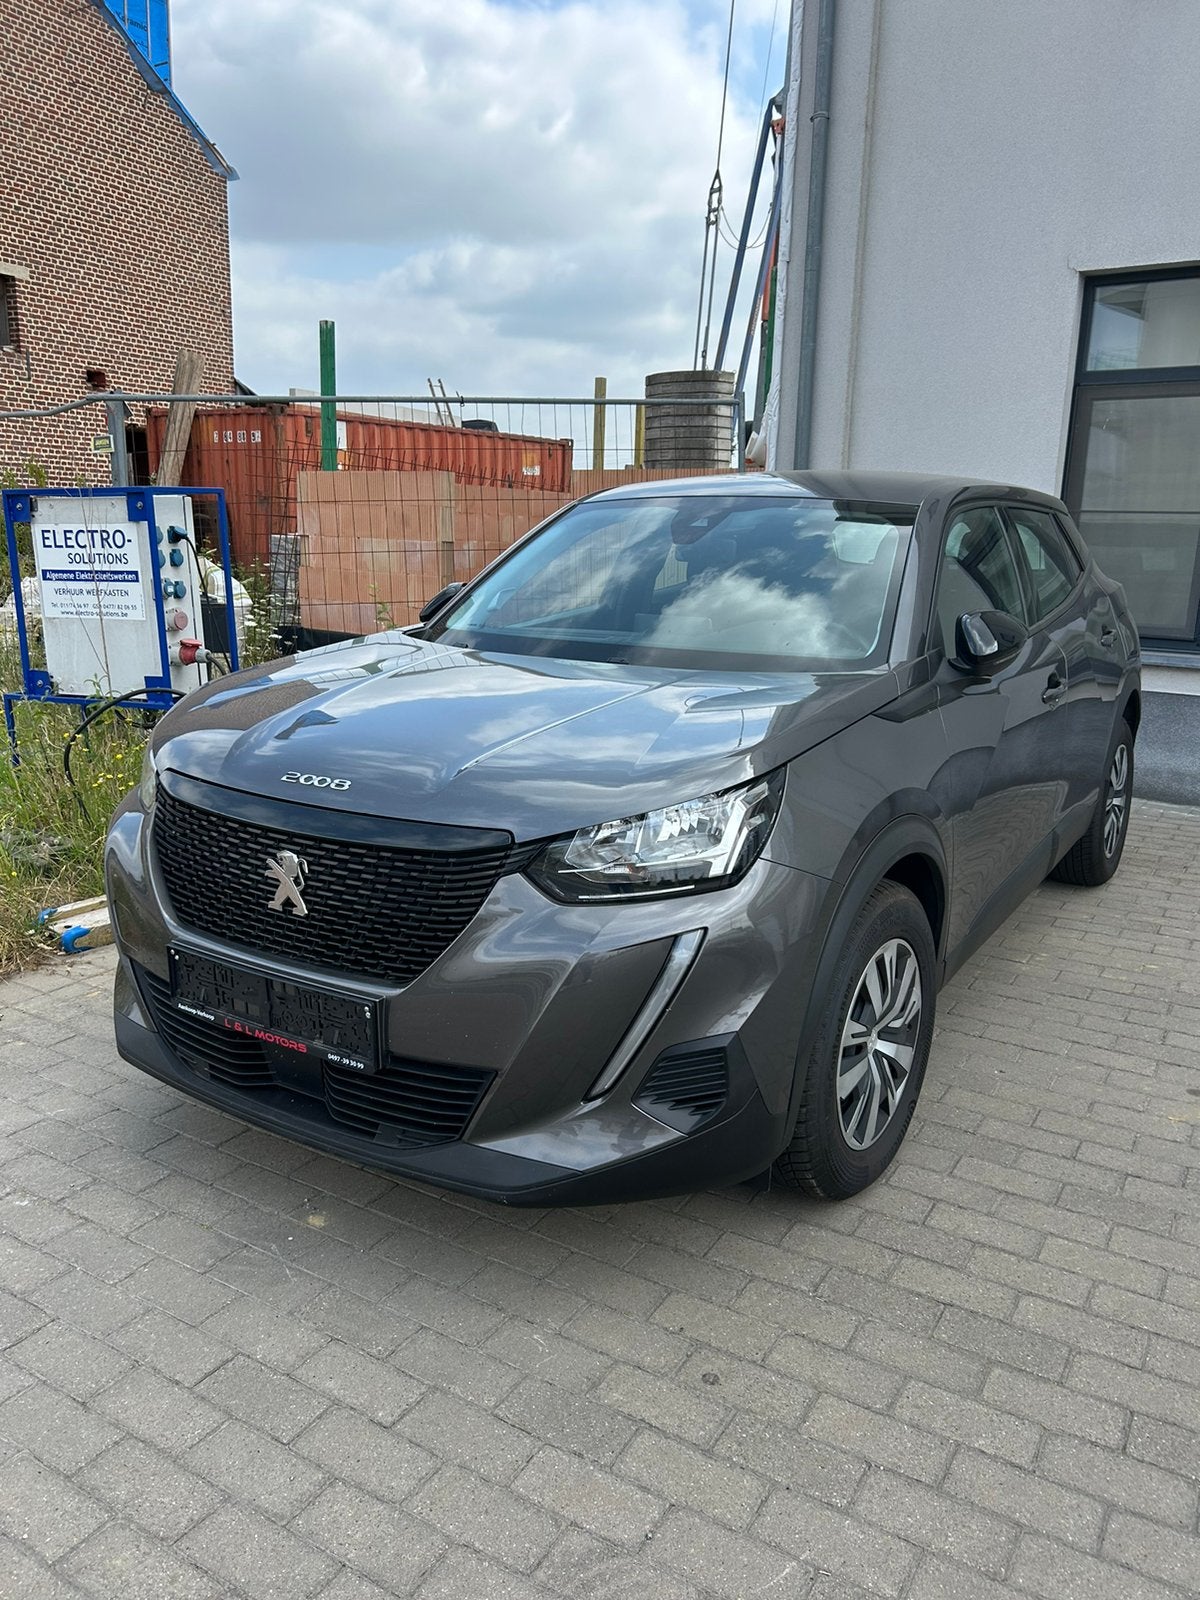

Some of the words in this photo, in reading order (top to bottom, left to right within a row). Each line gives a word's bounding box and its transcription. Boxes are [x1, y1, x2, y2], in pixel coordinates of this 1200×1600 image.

[41, 529, 132, 549] ELECTRO-
[67, 552, 129, 565] SOLUTIONS
[46, 571, 74, 581] Algemene
[54, 587, 85, 597] VERHUUR
[280, 771, 352, 791] 2008
[224, 1018, 232, 1028] L
[234, 1022, 242, 1032] &
[245, 1025, 253, 1036] L
[254, 1029, 308, 1054] MOTORS
